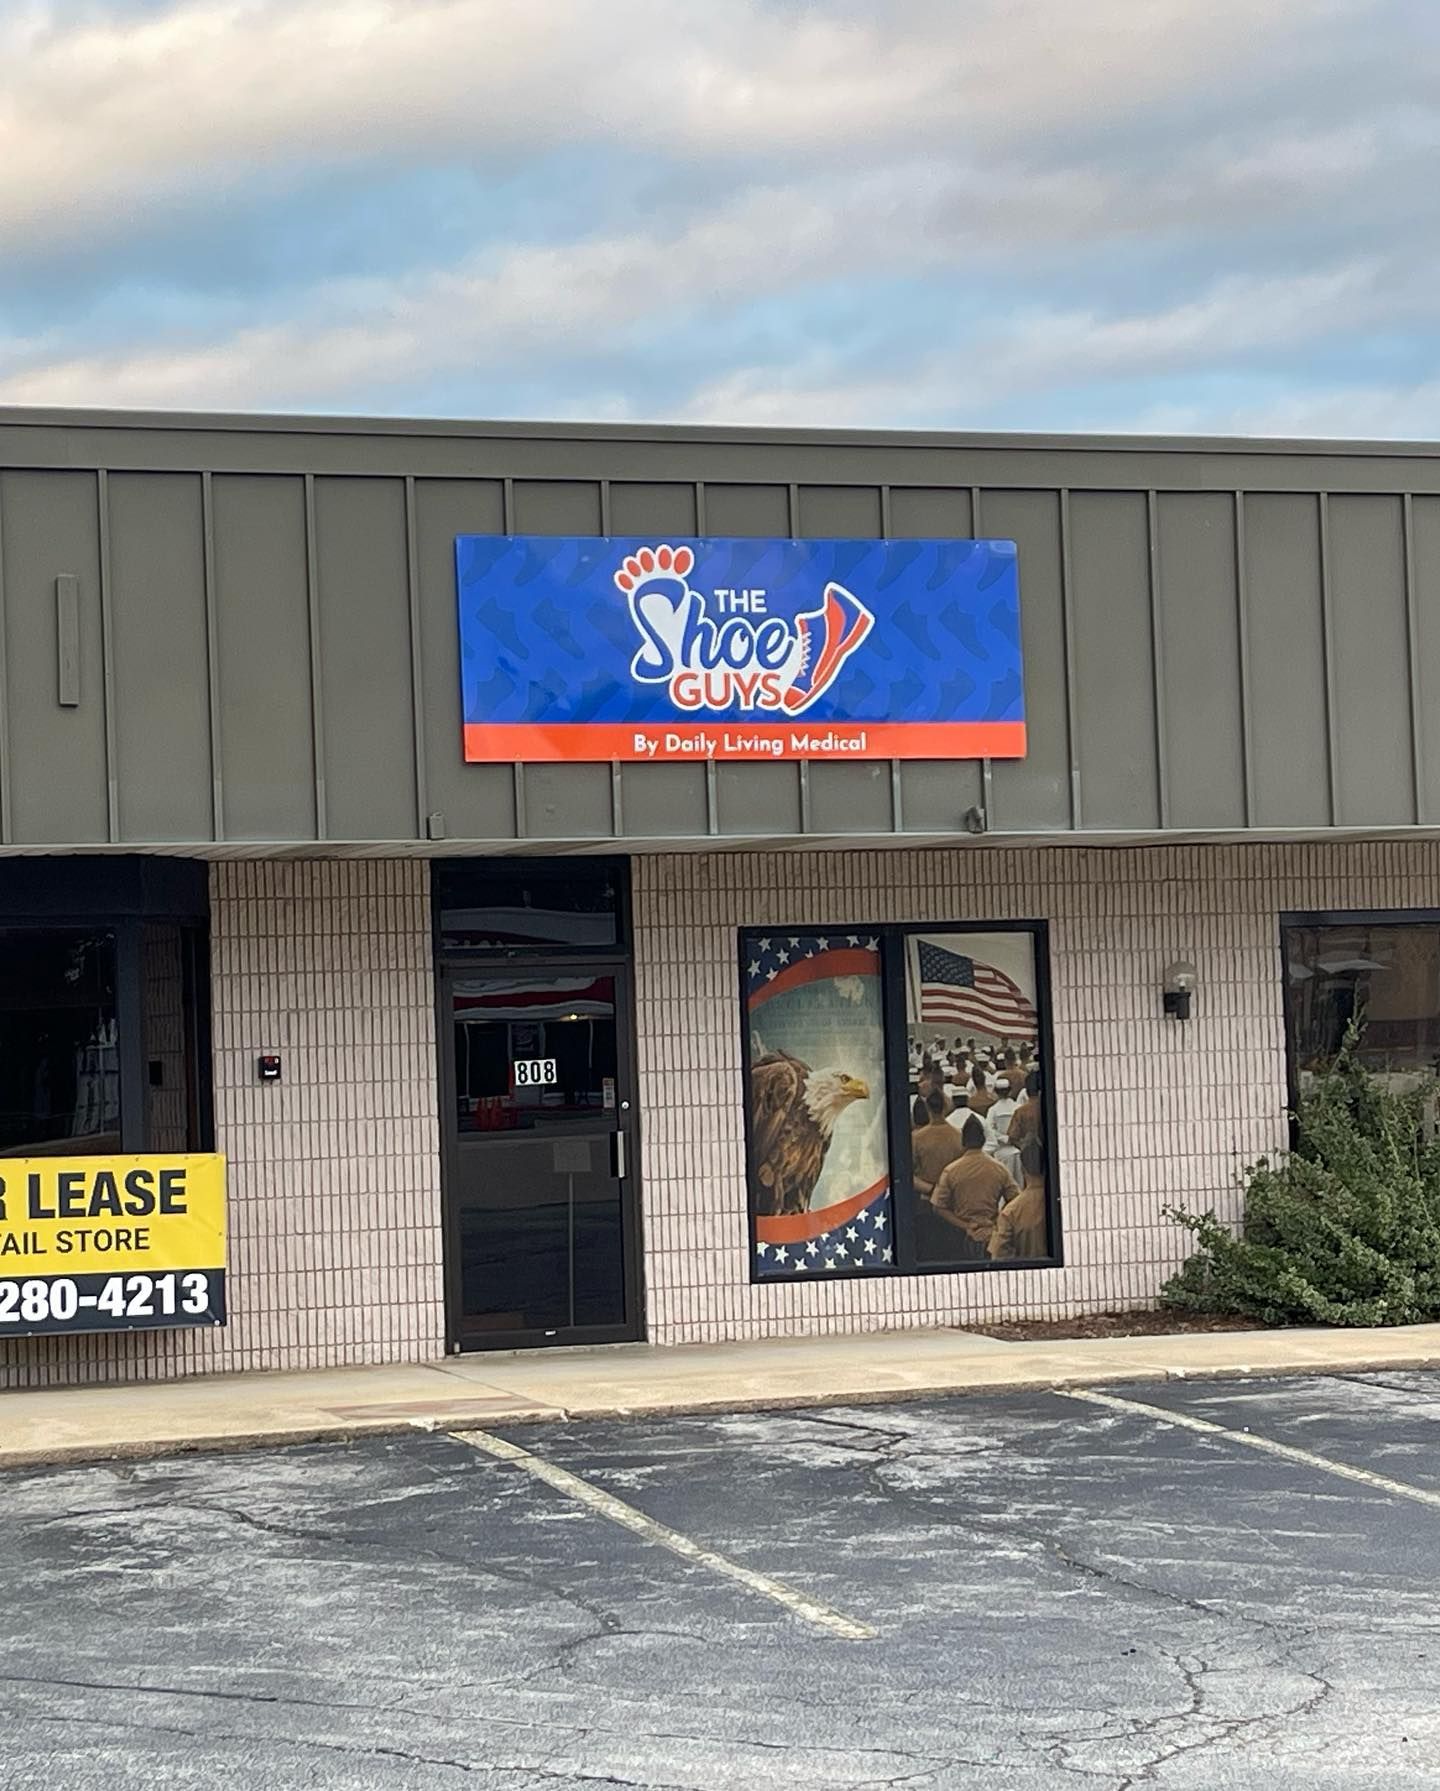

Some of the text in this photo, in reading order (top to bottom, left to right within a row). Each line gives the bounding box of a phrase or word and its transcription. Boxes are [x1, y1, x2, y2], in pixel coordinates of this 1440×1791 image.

[714, 589, 768, 613] THE
[634, 577, 795, 679] Shoe
[672, 671, 782, 708] GUYS
[633, 731, 867, 758] By Daily Living Medical
[516, 1060, 555, 1084] 808
[28, 1169, 188, 1219] LEASE
[0, 1227, 151, 1256] AIL STORE
[0, 1273, 209, 1323] 280-4213
